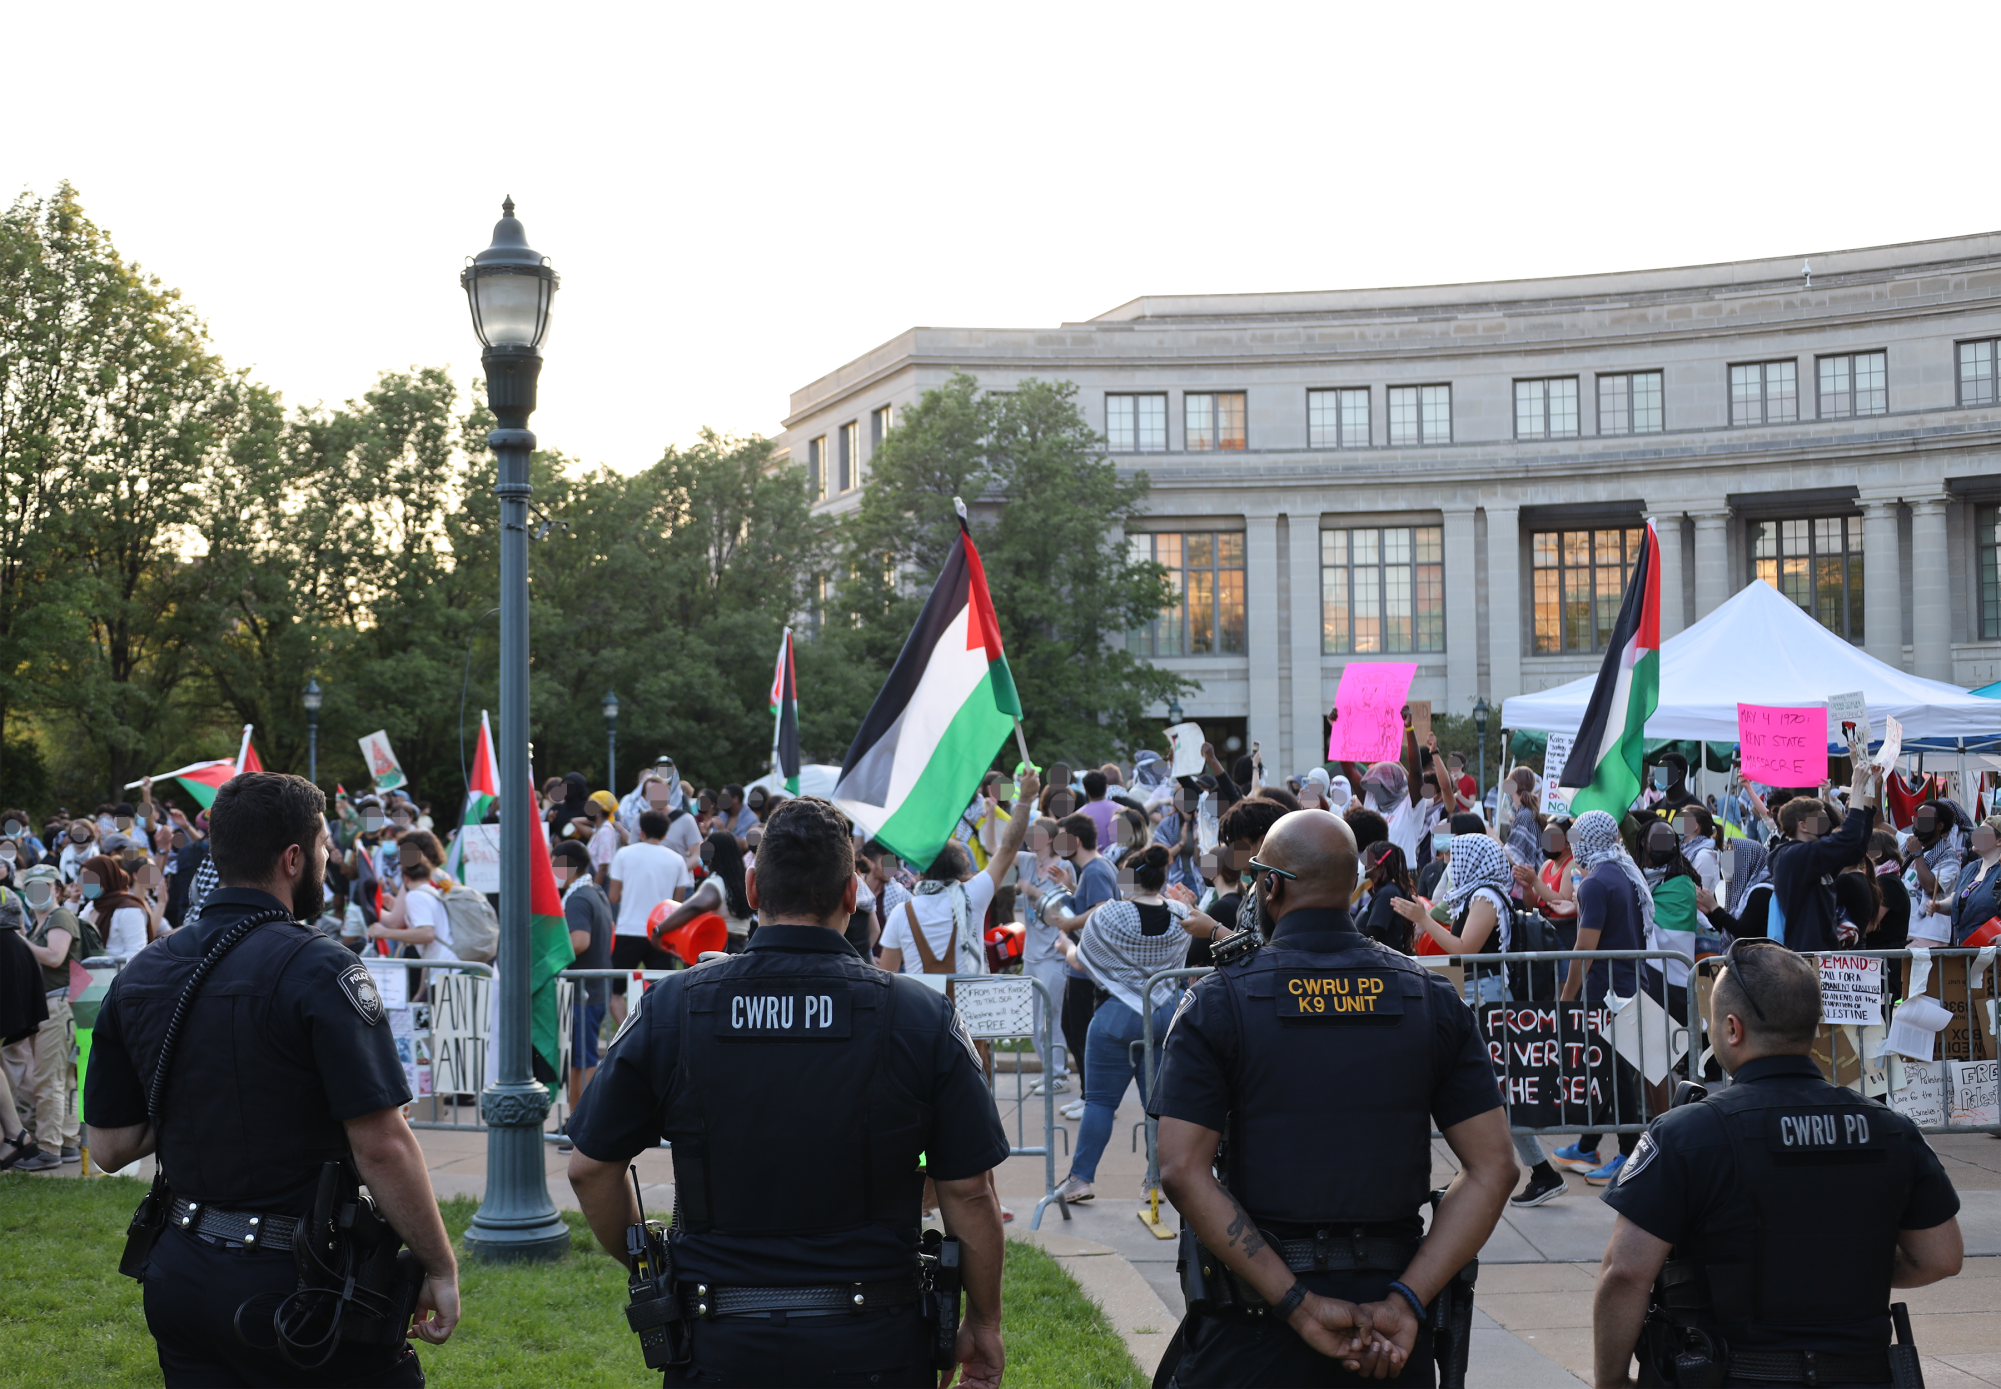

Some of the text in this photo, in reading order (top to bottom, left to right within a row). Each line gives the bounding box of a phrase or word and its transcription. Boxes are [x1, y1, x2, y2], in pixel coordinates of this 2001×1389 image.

[1741, 709, 1756, 724] MAY
[1762, 712, 1770, 725] 4
[1746, 729, 1807, 747] KENT STATE
[1745, 754, 1806, 774] MASSACRE
[1868, 959, 1882, 972] 5
[349, 972, 370, 985] POLICE
[1820, 970, 1836, 980] CALL
[1839, 971, 1855, 982] FOR
[968, 988, 991, 997] FROM
[992, 987, 1007, 995] THE
[1288, 977, 1385, 995] CWRU PD
[1821, 981, 1850, 991] RMANENT
[1821, 992, 1829, 1000] ND
[1840, 993, 1854, 1002] END
[1298, 995, 1378, 1013] K9 UNIT
[1822, 1000, 1853, 1008] CCUPATION
[731, 995, 833, 1029] CWRU PD
[996, 1007, 1006, 1016] will
[1011, 1007, 1020, 1015] be
[1823, 1009, 1868, 1020] LESTINE
[977, 1019, 1007, 1031] FREE
[1487, 1008, 1557, 1037] FROM
[1951, 1028, 1982, 1041] BOX
[1488, 1039, 1603, 1068] RIVER TO
[1497, 1075, 1603, 1106] THE SEA
[1937, 1087, 1955, 1097] Lnd
[1780, 1113, 1870, 1147] CWRU PD
